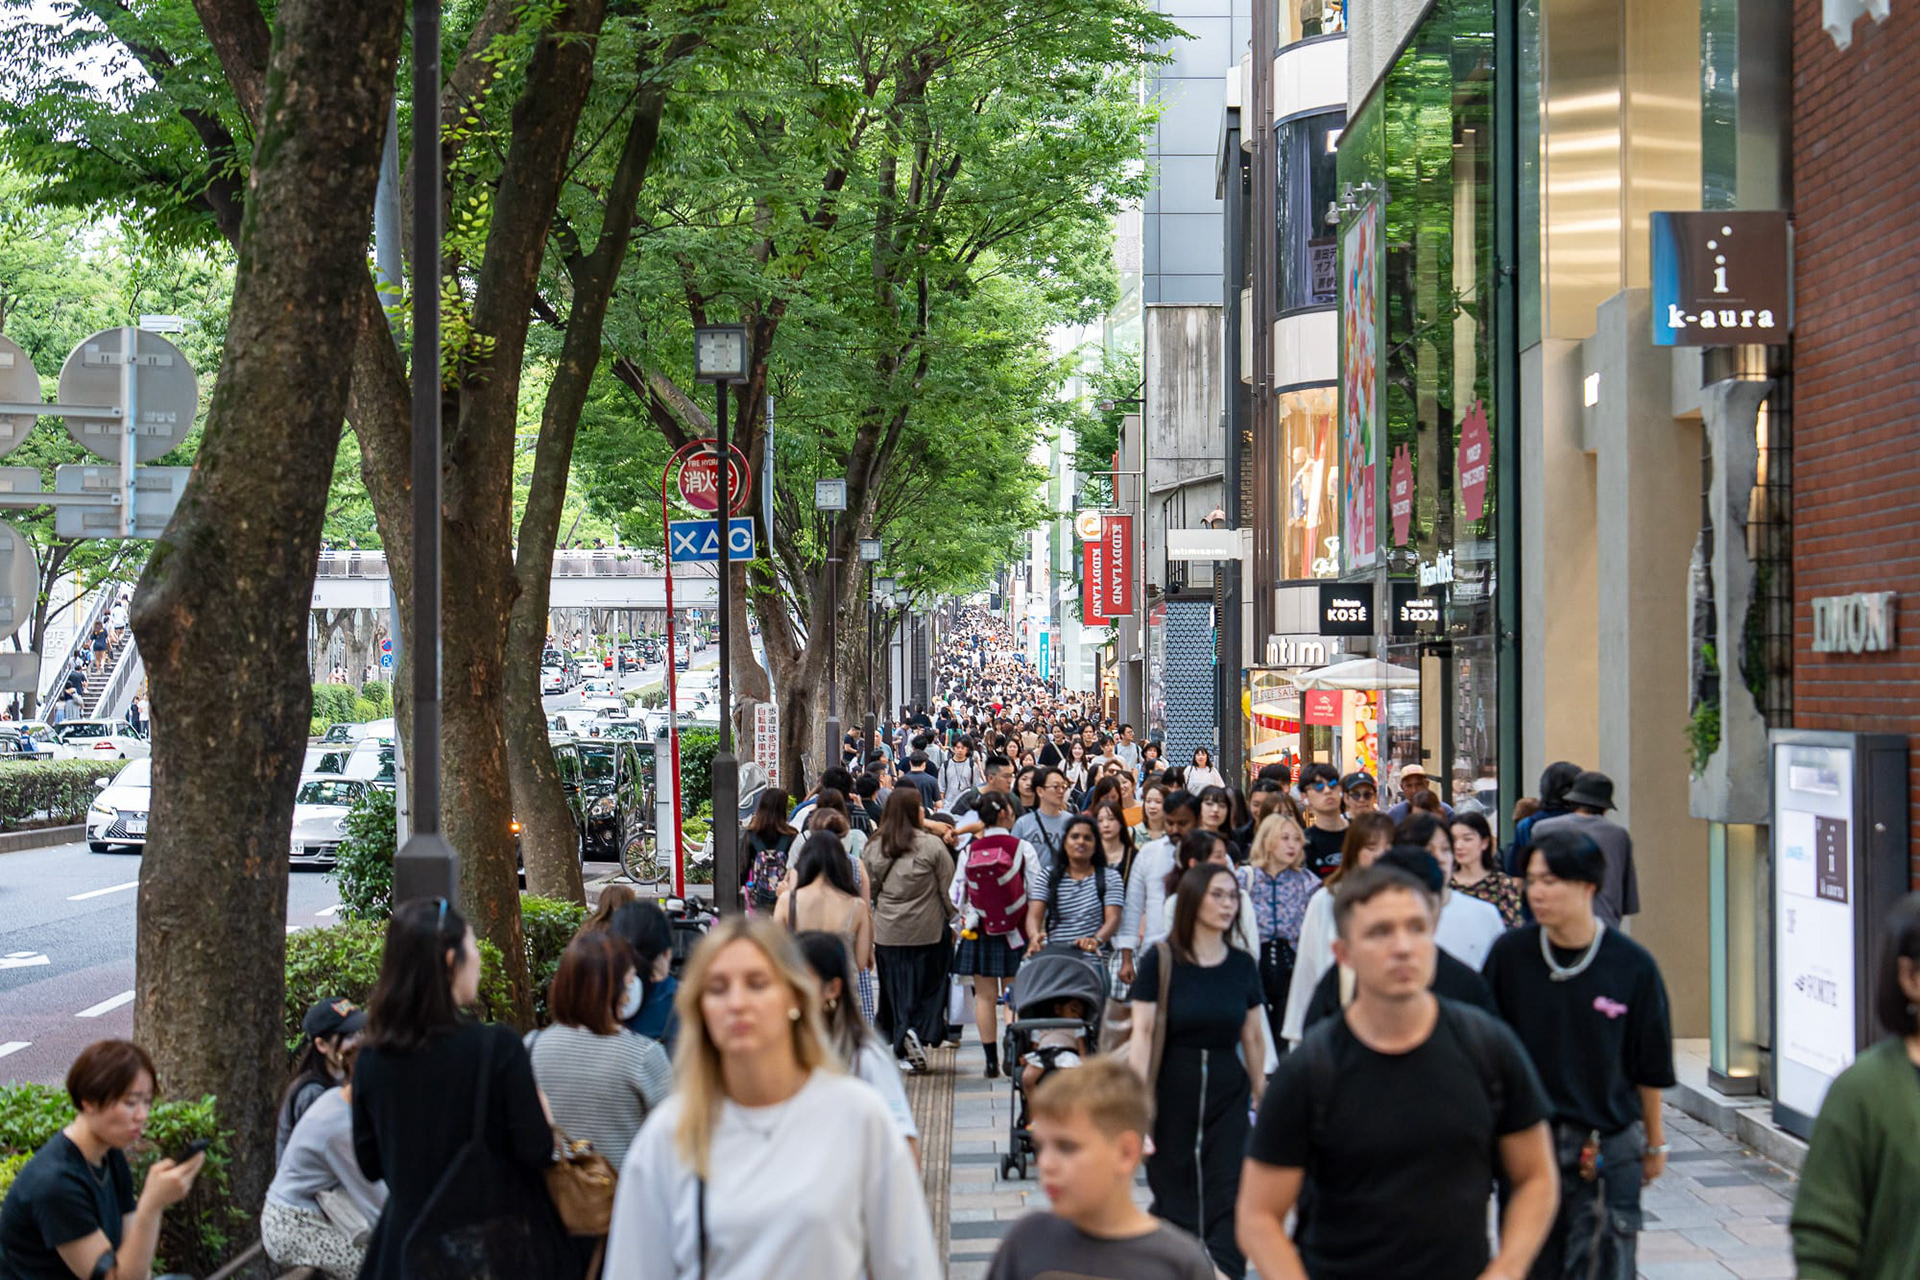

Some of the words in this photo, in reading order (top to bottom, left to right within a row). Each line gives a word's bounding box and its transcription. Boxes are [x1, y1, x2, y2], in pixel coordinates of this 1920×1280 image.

[1667, 303, 1775, 328] k-aura
[688, 459, 700, 467] FIRE
[701, 458, 719, 466] HYDR
[1327, 607, 1367, 622] KOSÉ
[1811, 591, 1896, 654] IMON
